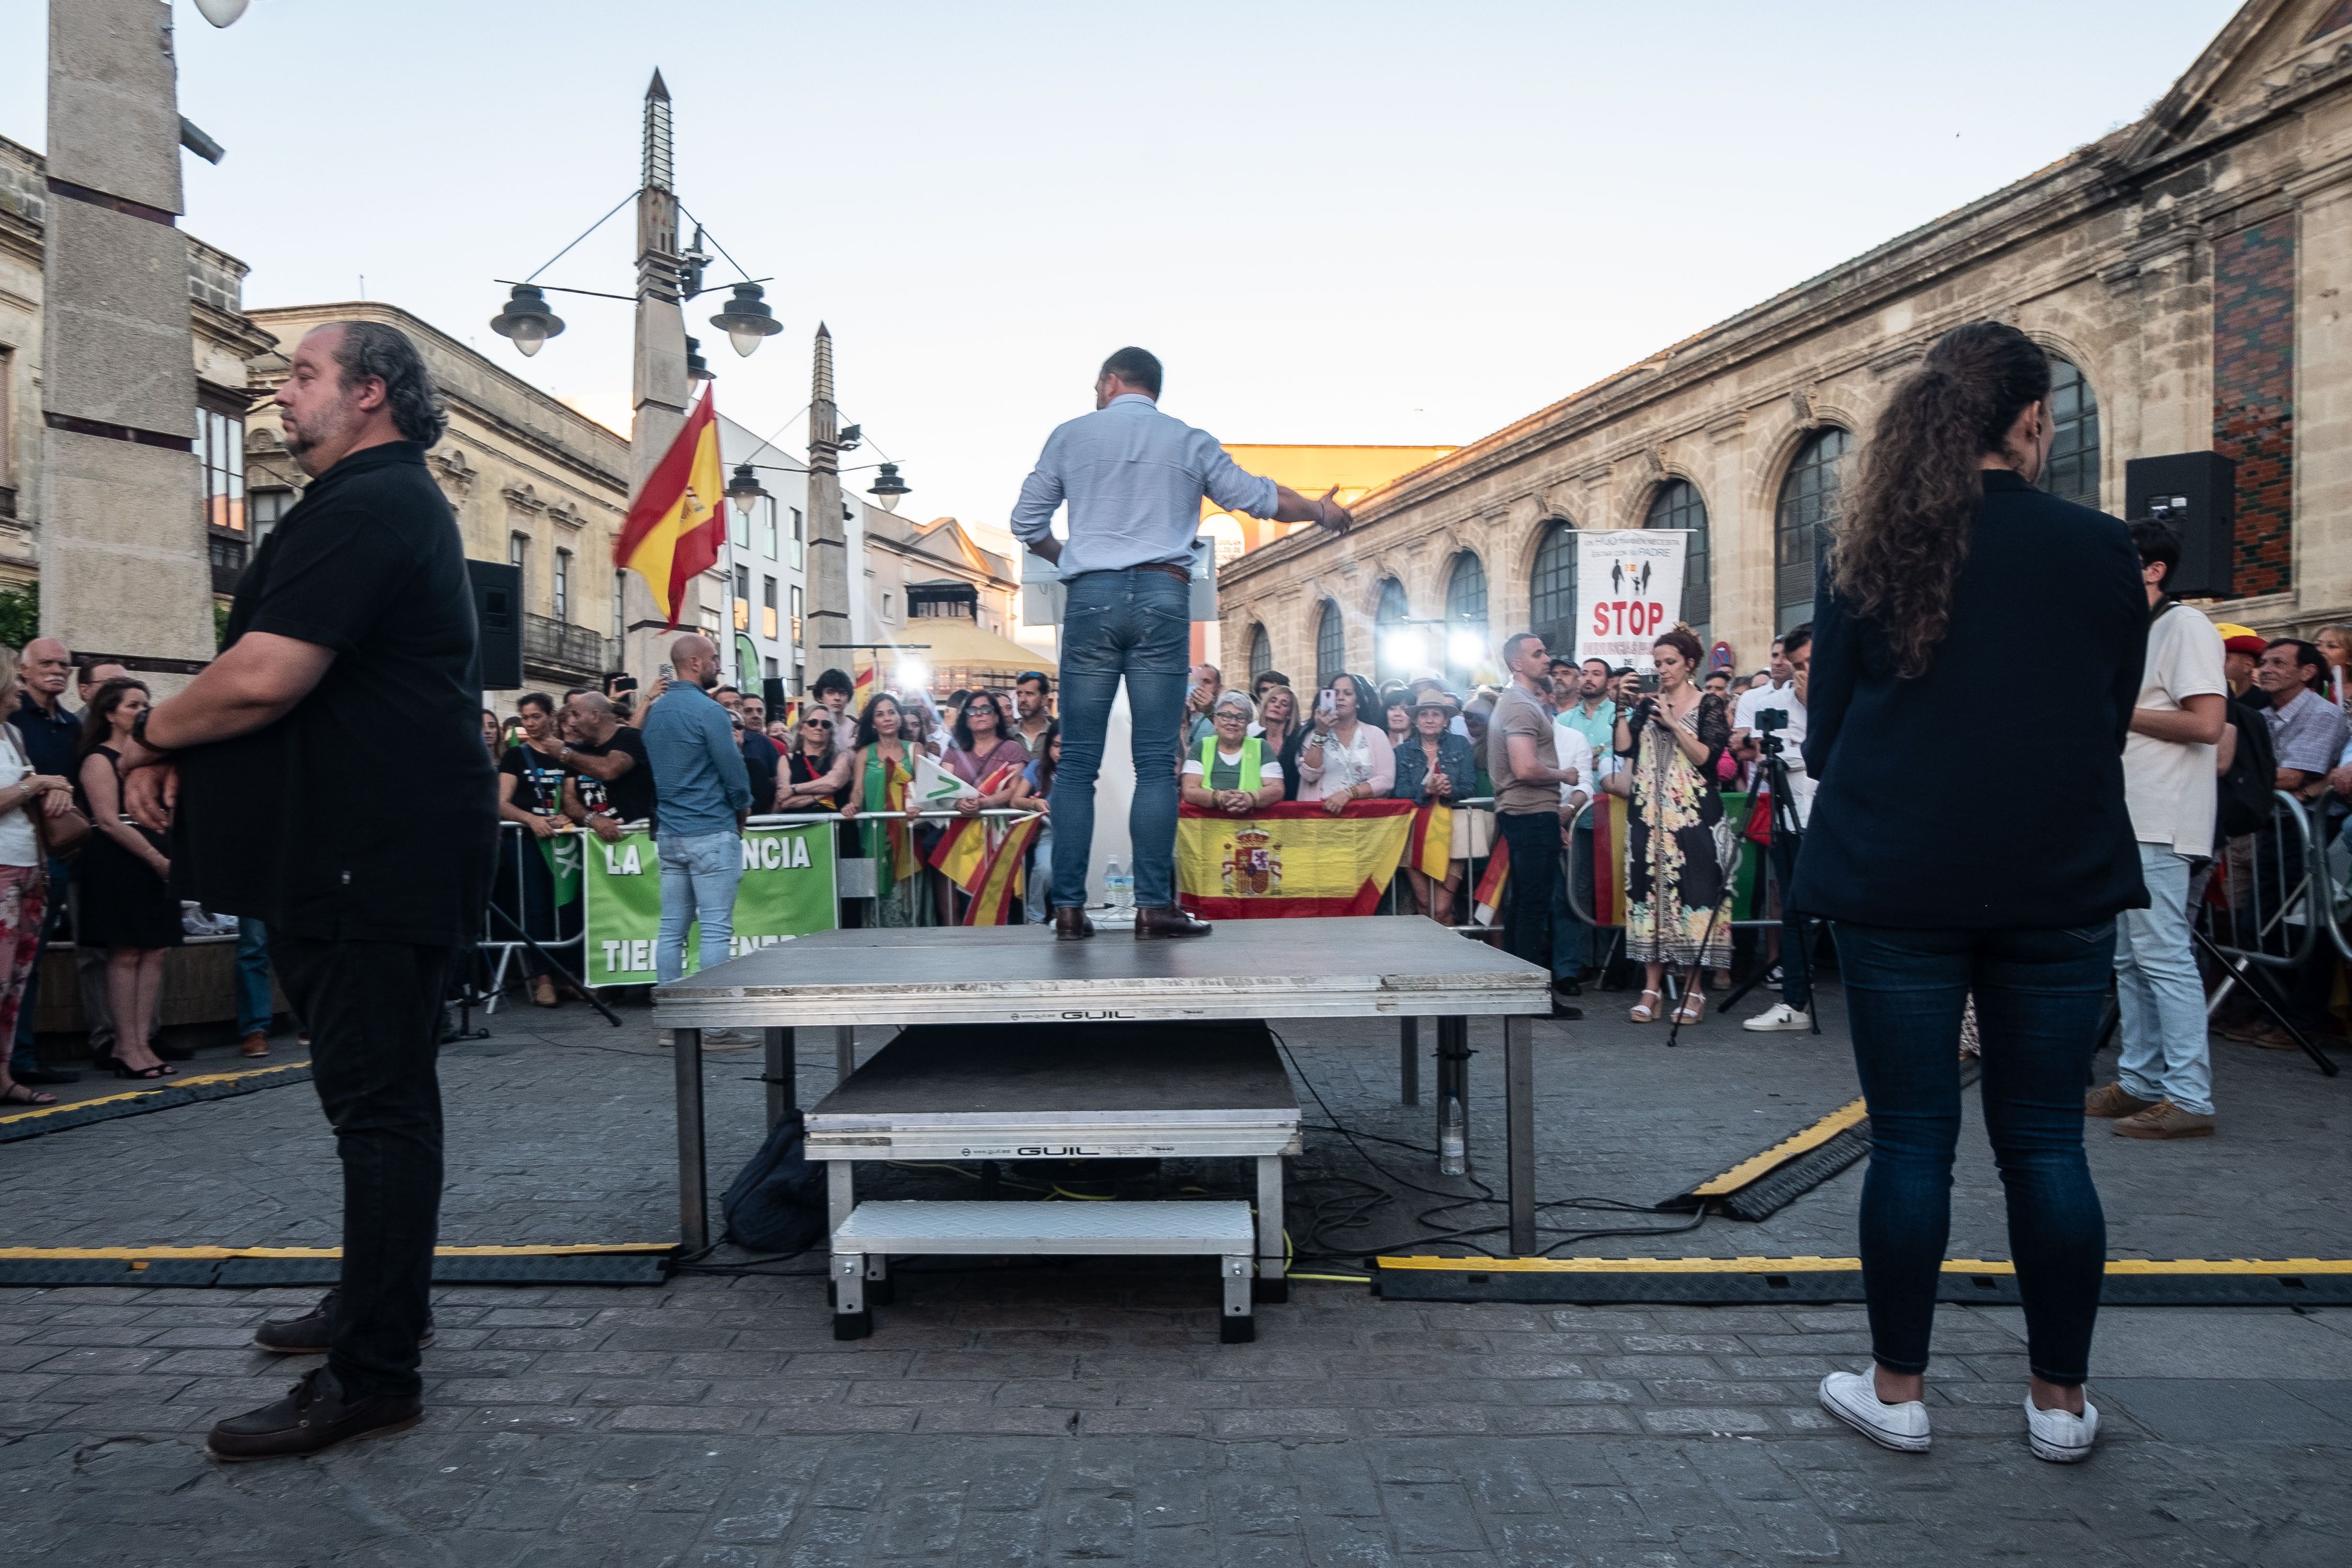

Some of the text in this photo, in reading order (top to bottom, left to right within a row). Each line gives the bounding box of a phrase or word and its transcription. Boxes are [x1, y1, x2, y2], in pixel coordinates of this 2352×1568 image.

[1639, 547, 1671, 557] PADRE
[1593, 601, 1664, 636] STOP
[605, 844, 642, 875] LA
[1061, 1011, 1135, 1019] GUIL
[1017, 1147, 1100, 1155] GUIL
